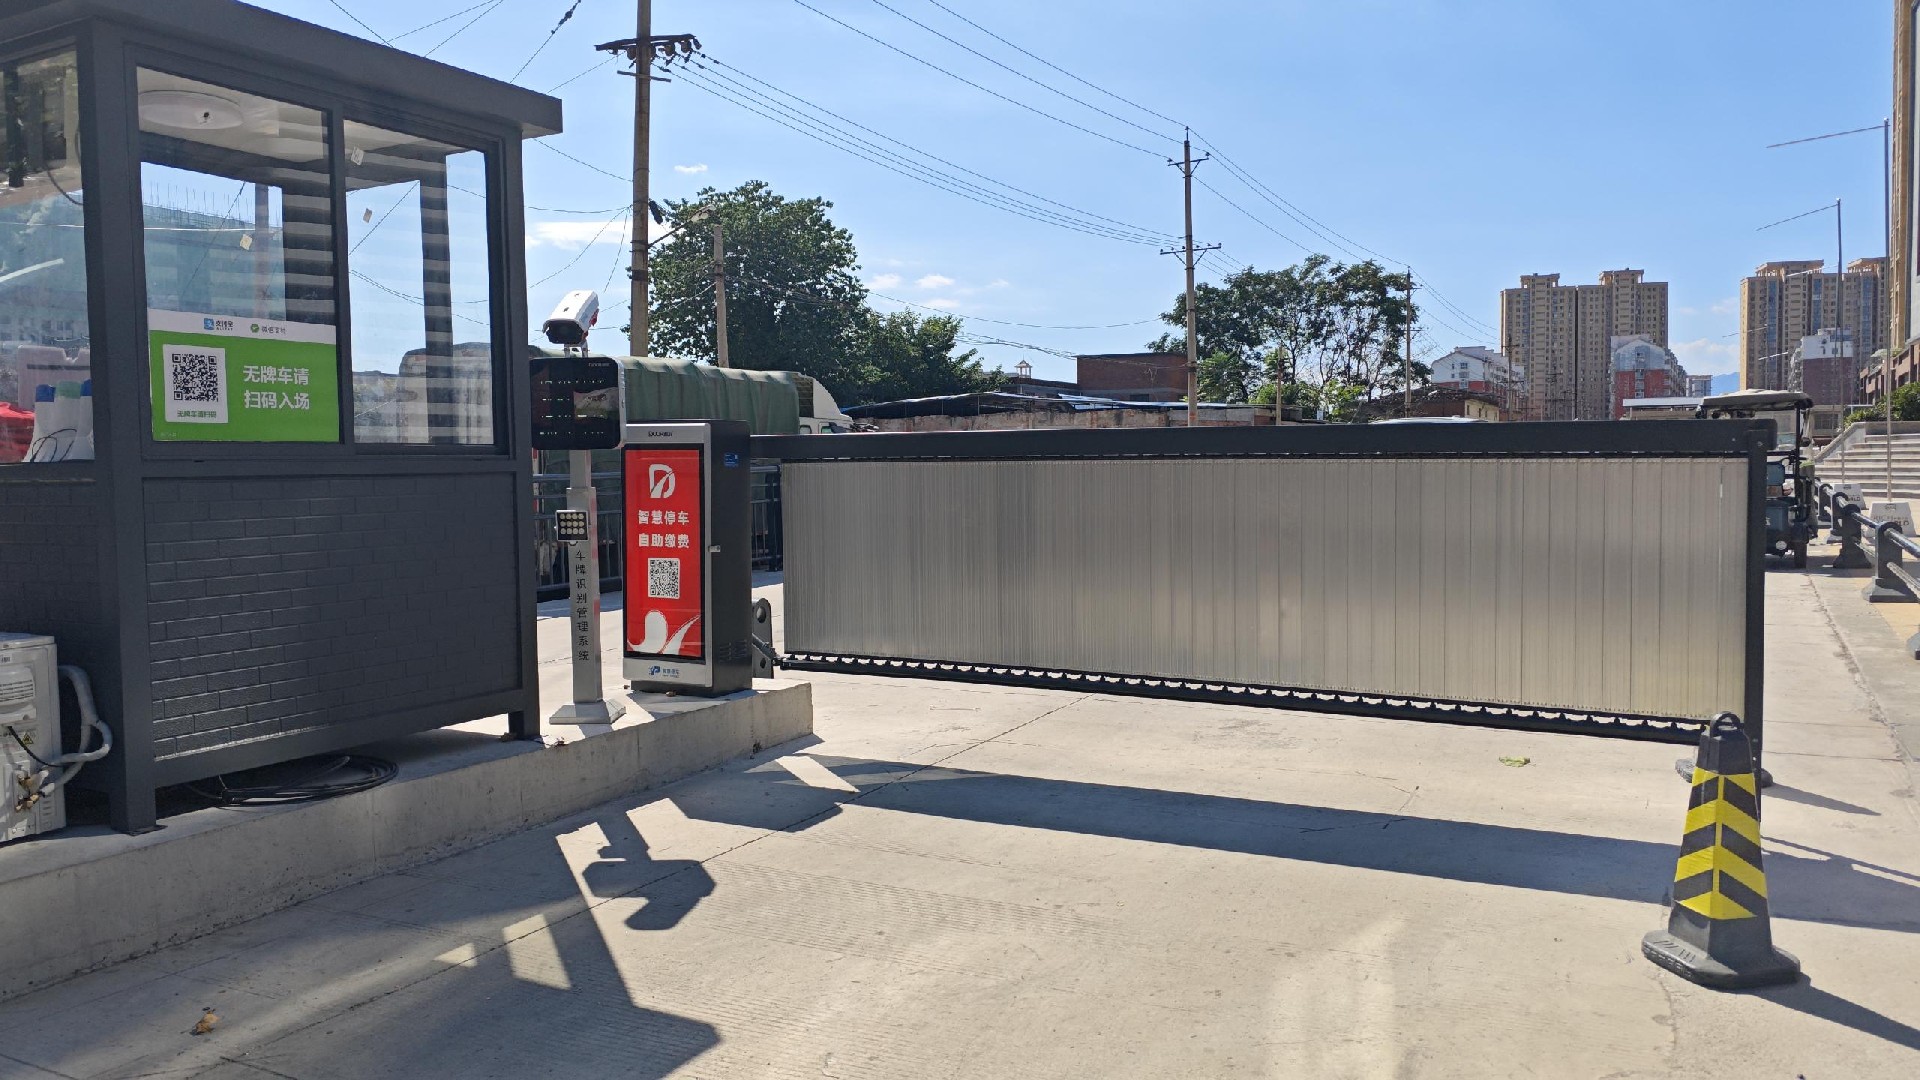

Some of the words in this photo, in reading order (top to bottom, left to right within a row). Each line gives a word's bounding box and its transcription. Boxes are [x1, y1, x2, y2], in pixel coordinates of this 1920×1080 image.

[243, 365, 310, 386] 无牌车请
[243, 390, 310, 411] 扫码入场
[638, 510, 690, 526] 智慧停车
[638, 533, 690, 549] 自助缴费
[575, 549, 590, 662] 车牌识别管理系统
